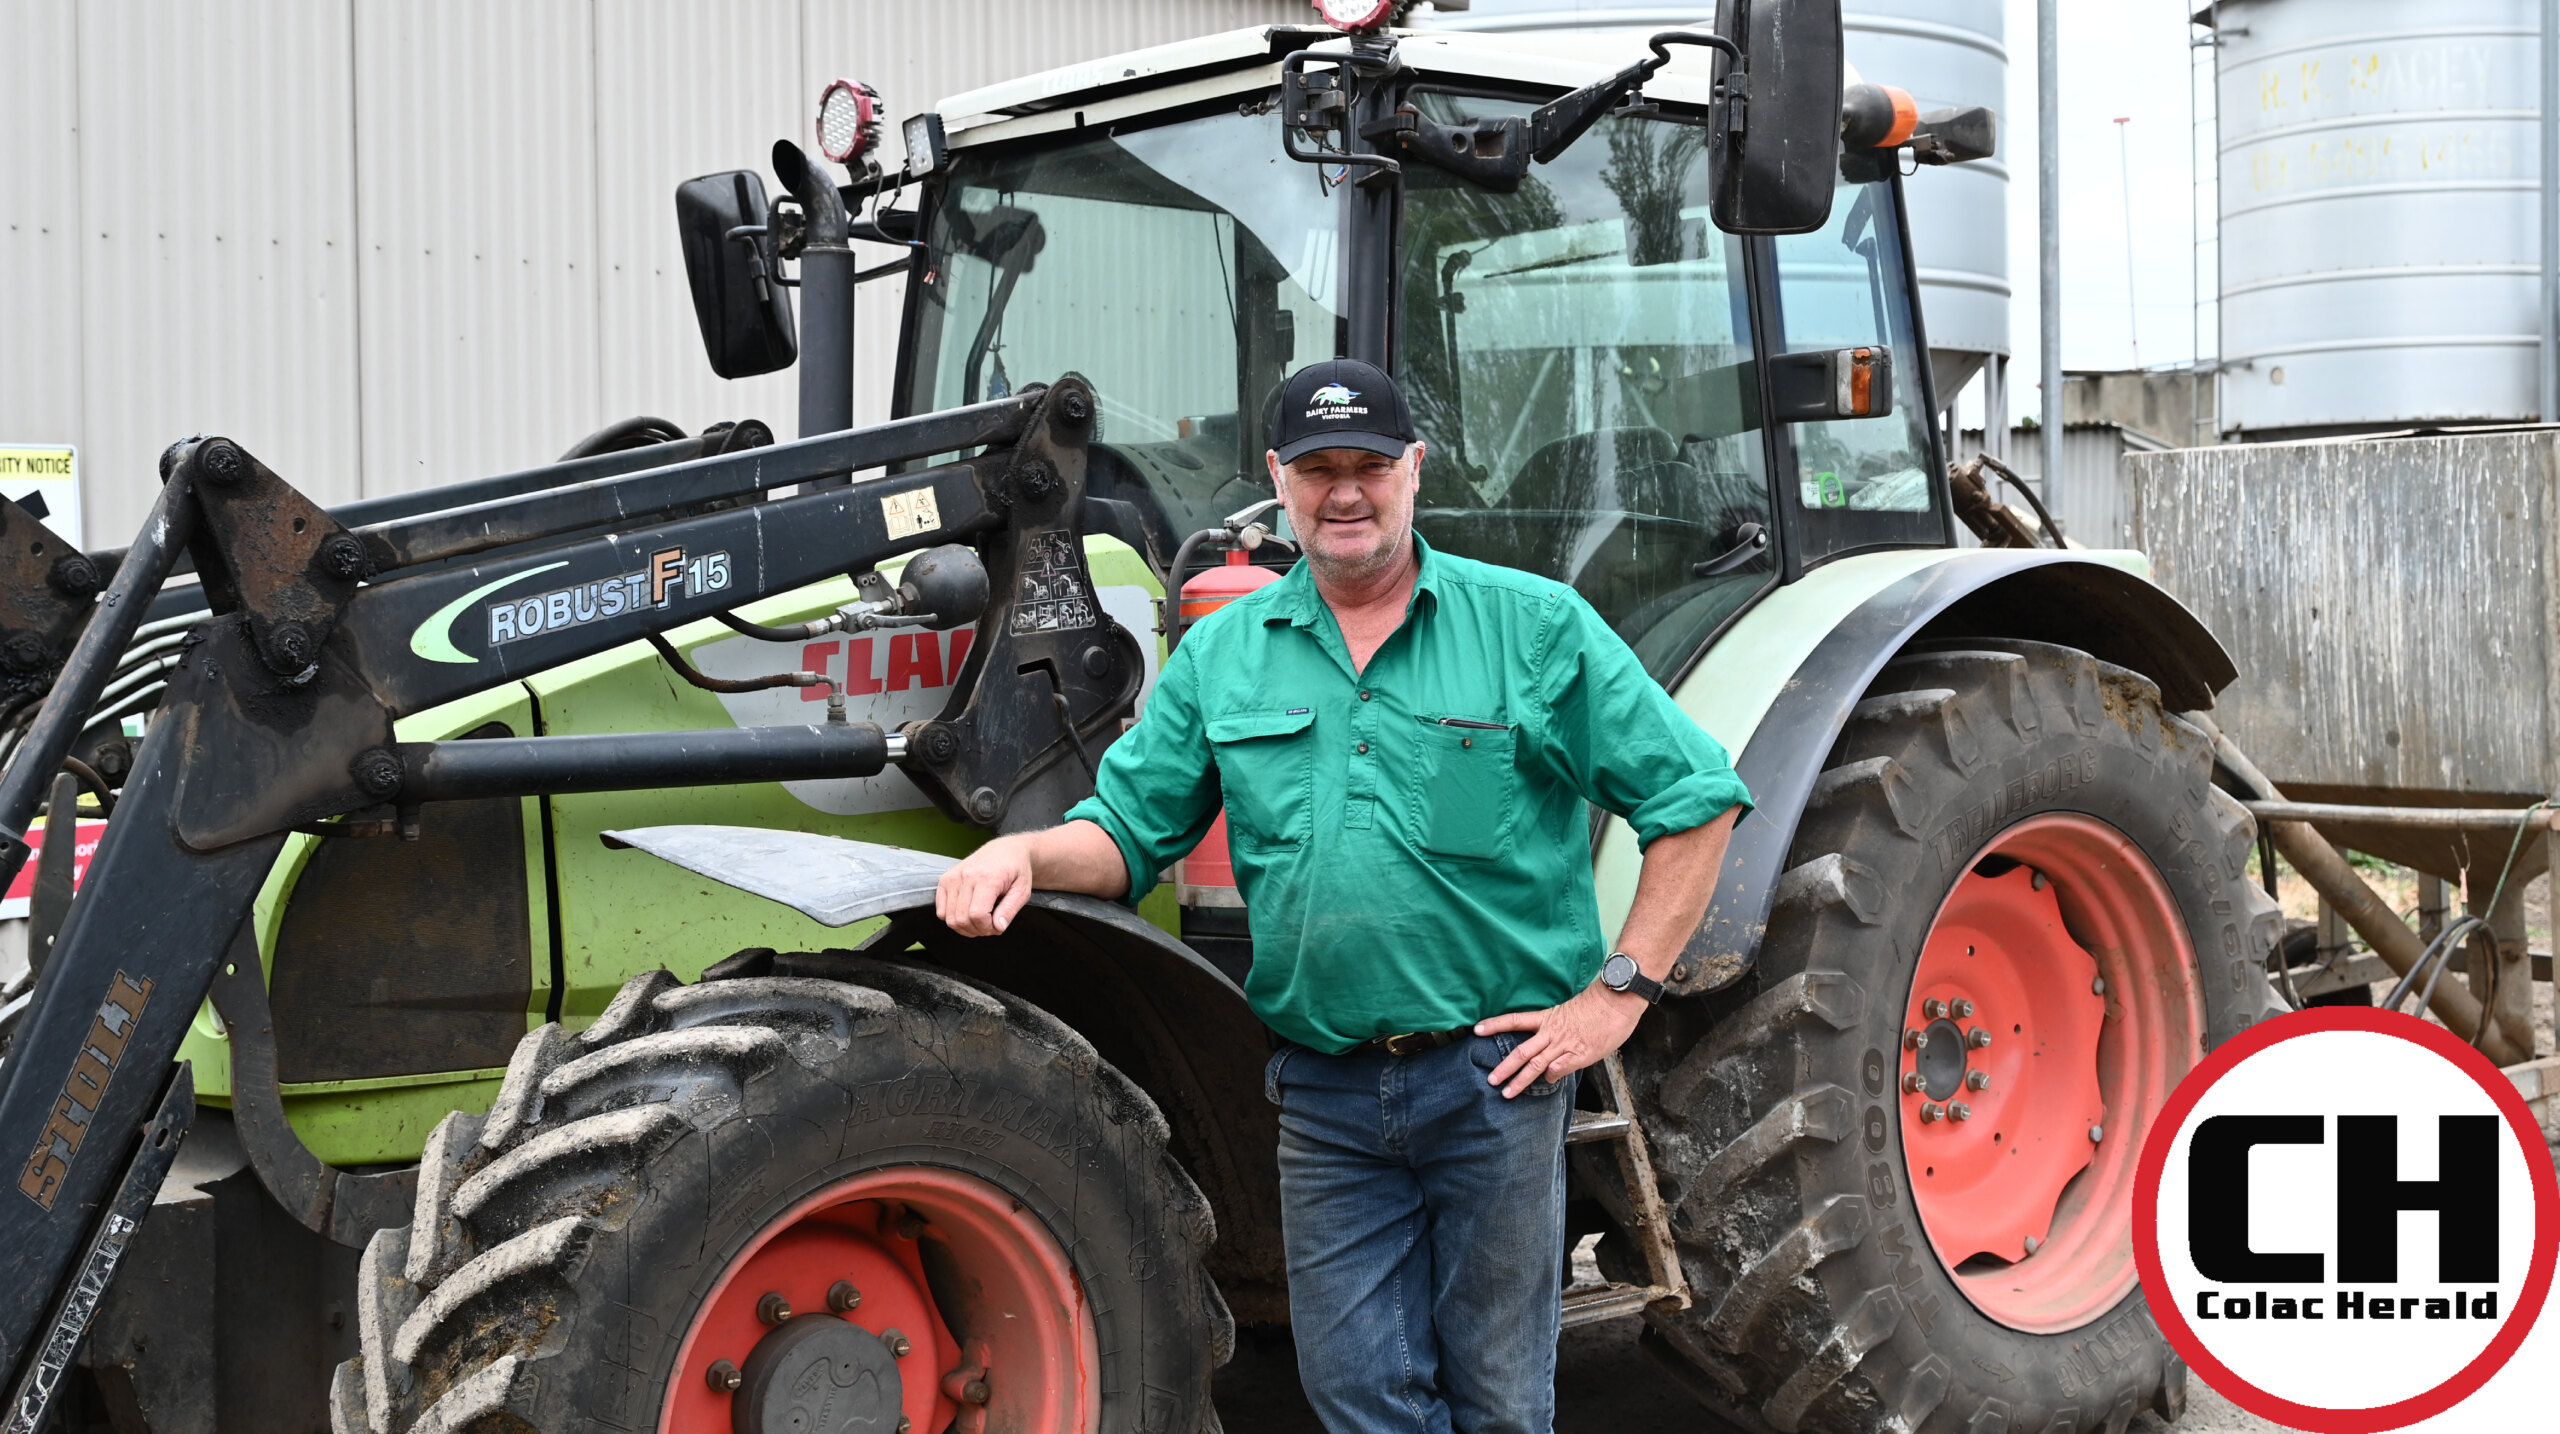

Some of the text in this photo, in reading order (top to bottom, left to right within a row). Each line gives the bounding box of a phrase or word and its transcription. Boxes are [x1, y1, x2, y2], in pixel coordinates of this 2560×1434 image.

[1305, 406, 1369, 419] DAIRY FARMERS
[26, 457, 71, 474] NOTICE
[490, 571, 647, 645] ROBUST
[1928, 747, 2097, 872] TRELLEBORG
[17, 968, 156, 1212] STOLL
